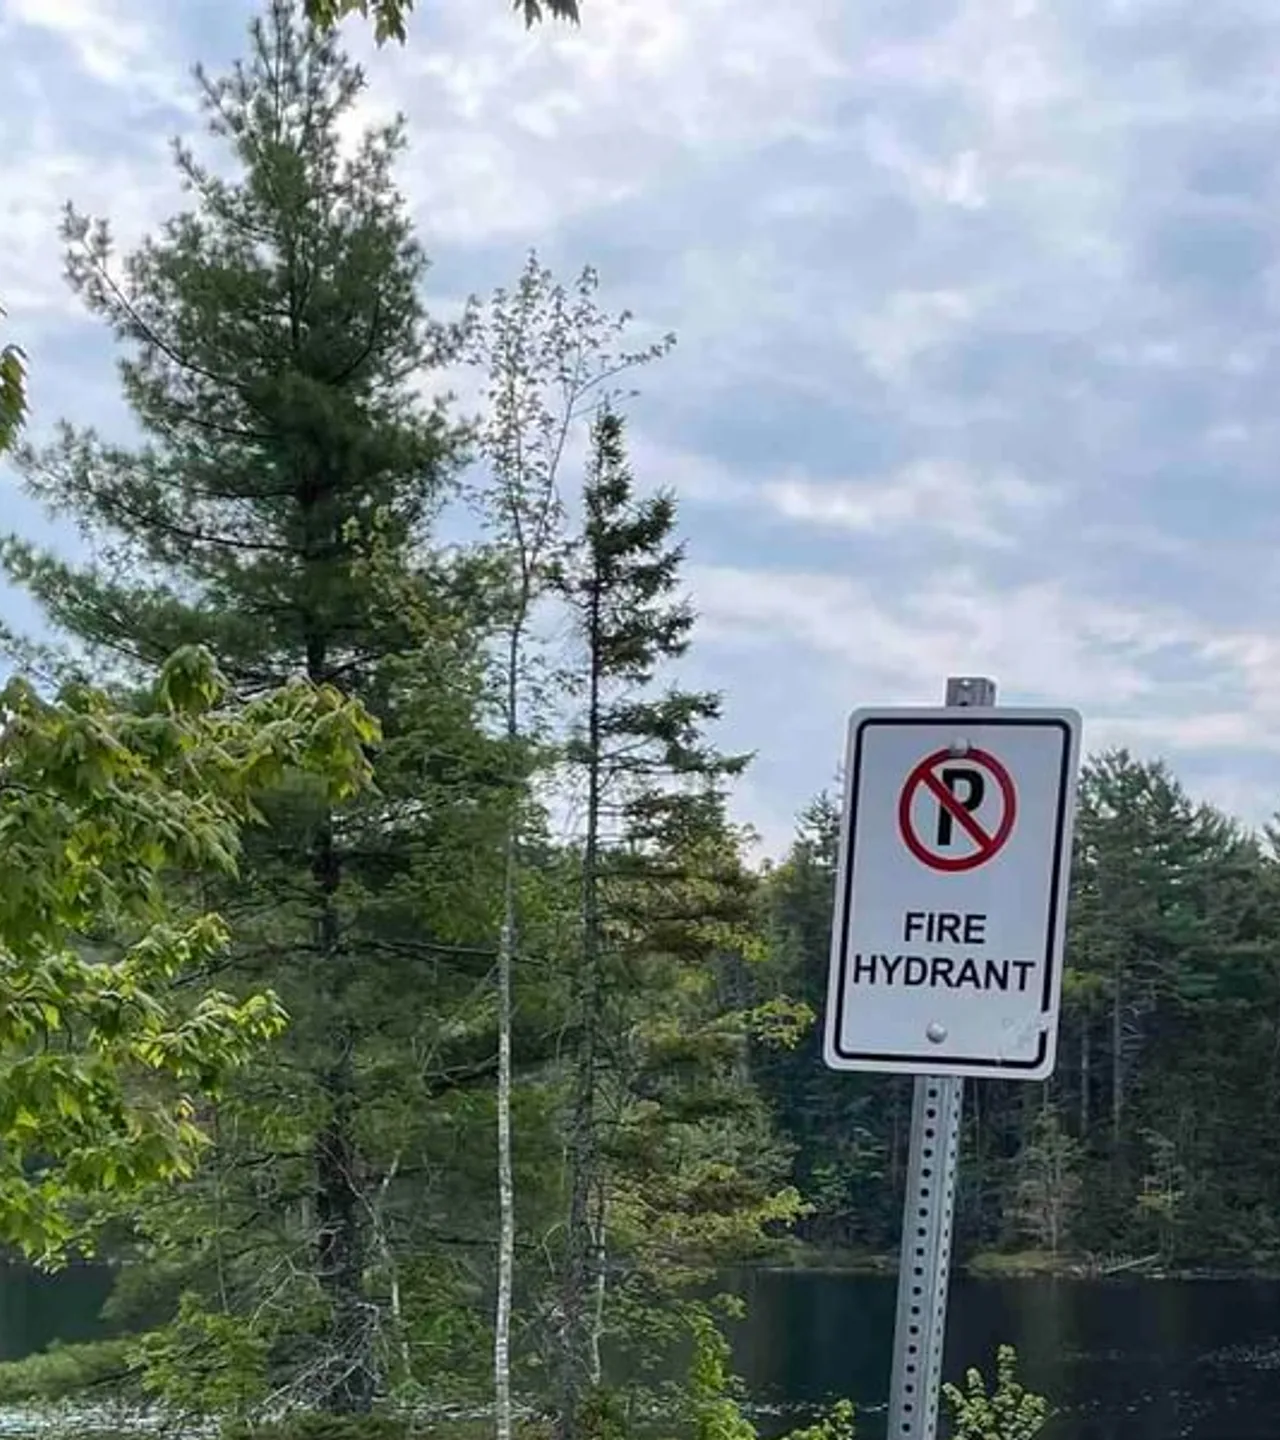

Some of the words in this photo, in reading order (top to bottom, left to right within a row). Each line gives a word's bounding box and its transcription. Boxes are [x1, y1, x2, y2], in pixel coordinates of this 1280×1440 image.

[936, 767, 985, 846] P
[903, 912, 987, 944] FIRE
[852, 954, 1037, 991] HYDRANT
